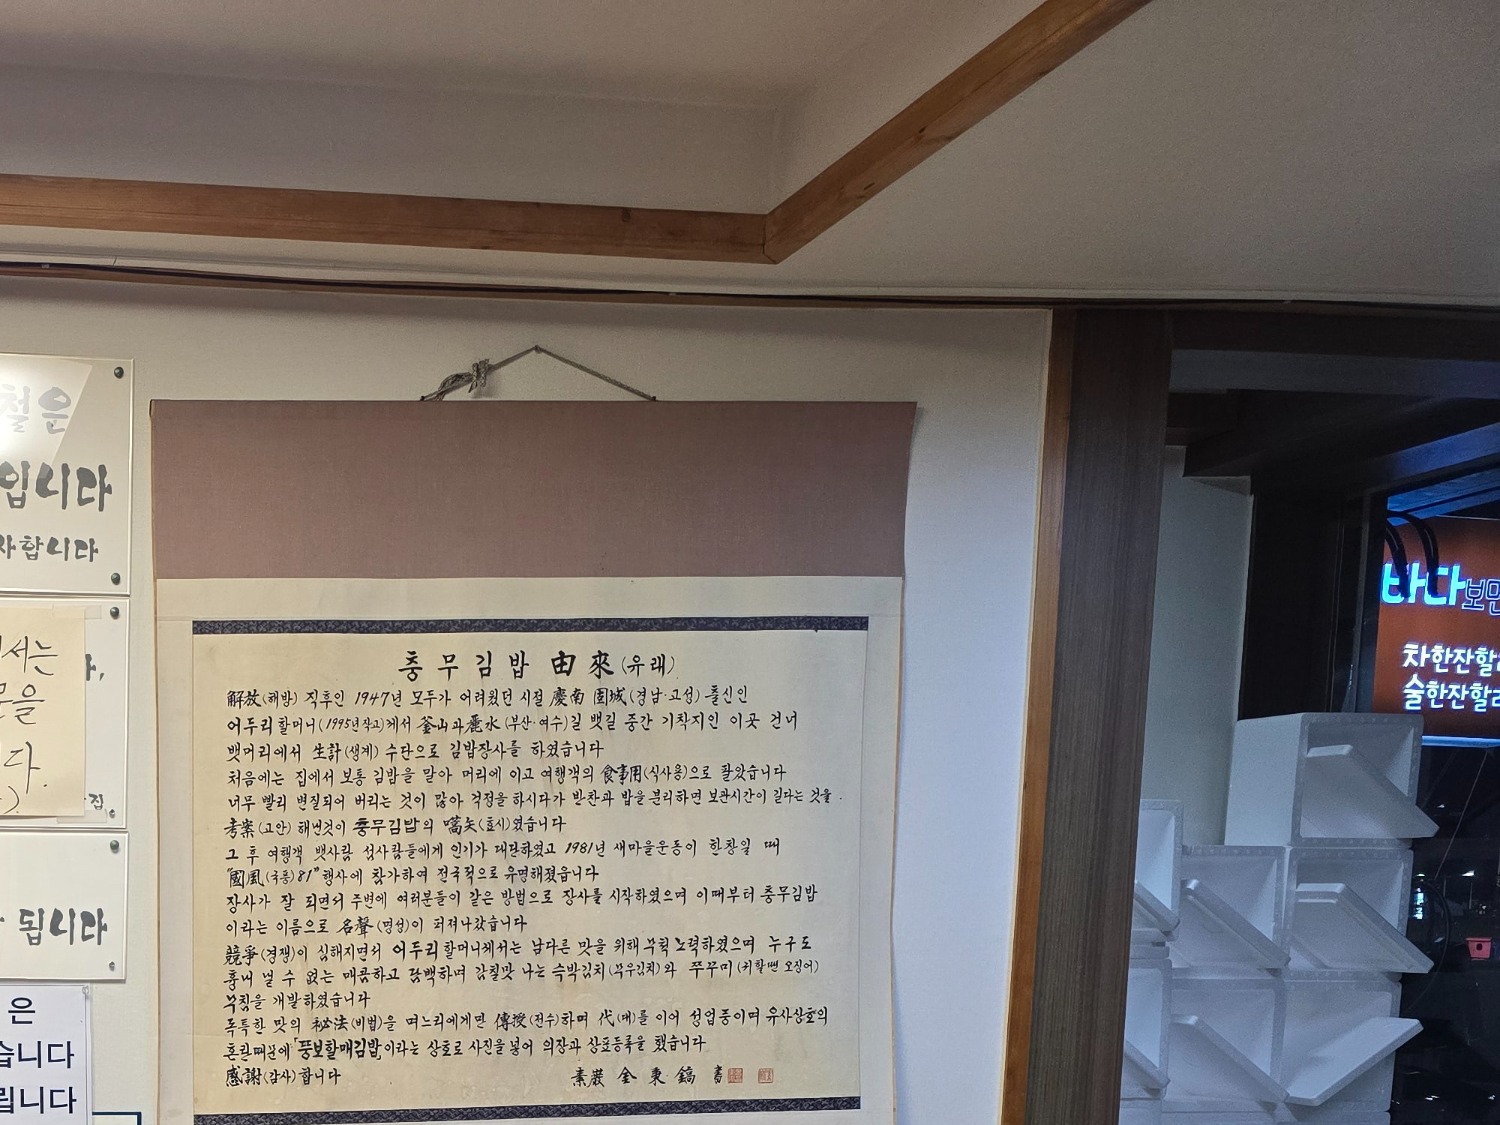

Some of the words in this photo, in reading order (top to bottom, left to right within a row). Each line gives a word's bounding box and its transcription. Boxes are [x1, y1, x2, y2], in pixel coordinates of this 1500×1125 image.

[227, 742, 301, 762] 뱃머리에서
[385, 743, 439, 762] 수단으로
[450, 740, 521, 761] 김밥장사를
[532, 740, 605, 758] 하였습니다
[228, 770, 285, 789] 처음에는
[295, 768, 334, 787] 집에서
[340, 769, 366, 785] 보통
[373, 767, 416, 785] 김밥을
[423, 765, 453, 784] 말아
[462, 766, 501, 784] 머리에
[510, 764, 534, 782] 이고
[540, 765, 594, 784] 여행객의
[721, 763, 787, 782] 팔았습니다
[225, 849, 238, 860] 그
[247, 845, 259, 862] 후
[267, 845, 303, 864] 여행객
[314, 843, 353, 863] 뱃사람
[363, 842, 444, 862] 섬사람들에게
[451, 842, 488, 859] 인기가
[494, 839, 556, 859] 대단하였고
[564, 841, 606, 858] 1981년
[614, 839, 697, 858] 새마을운동이
[709, 837, 750, 857] 한창일
[764, 837, 780, 855] 때
[226, 893, 271, 914] 장사가
[281, 893, 294, 911] 잘
[306, 893, 345, 912] 되면서
[350, 891, 387, 910] 주변에
[397, 889, 461, 908] 여러분들이
[469, 888, 494, 906] 같은
[501, 888, 554, 906] 방법으로
[563, 886, 603, 905] 장사를
[609, 886, 687, 906] 시작하였으며
[696, 885, 755, 904] 이때부터
[760, 884, 818, 903] 충무김밥
[18, 907, 107, 946] 됩니다
